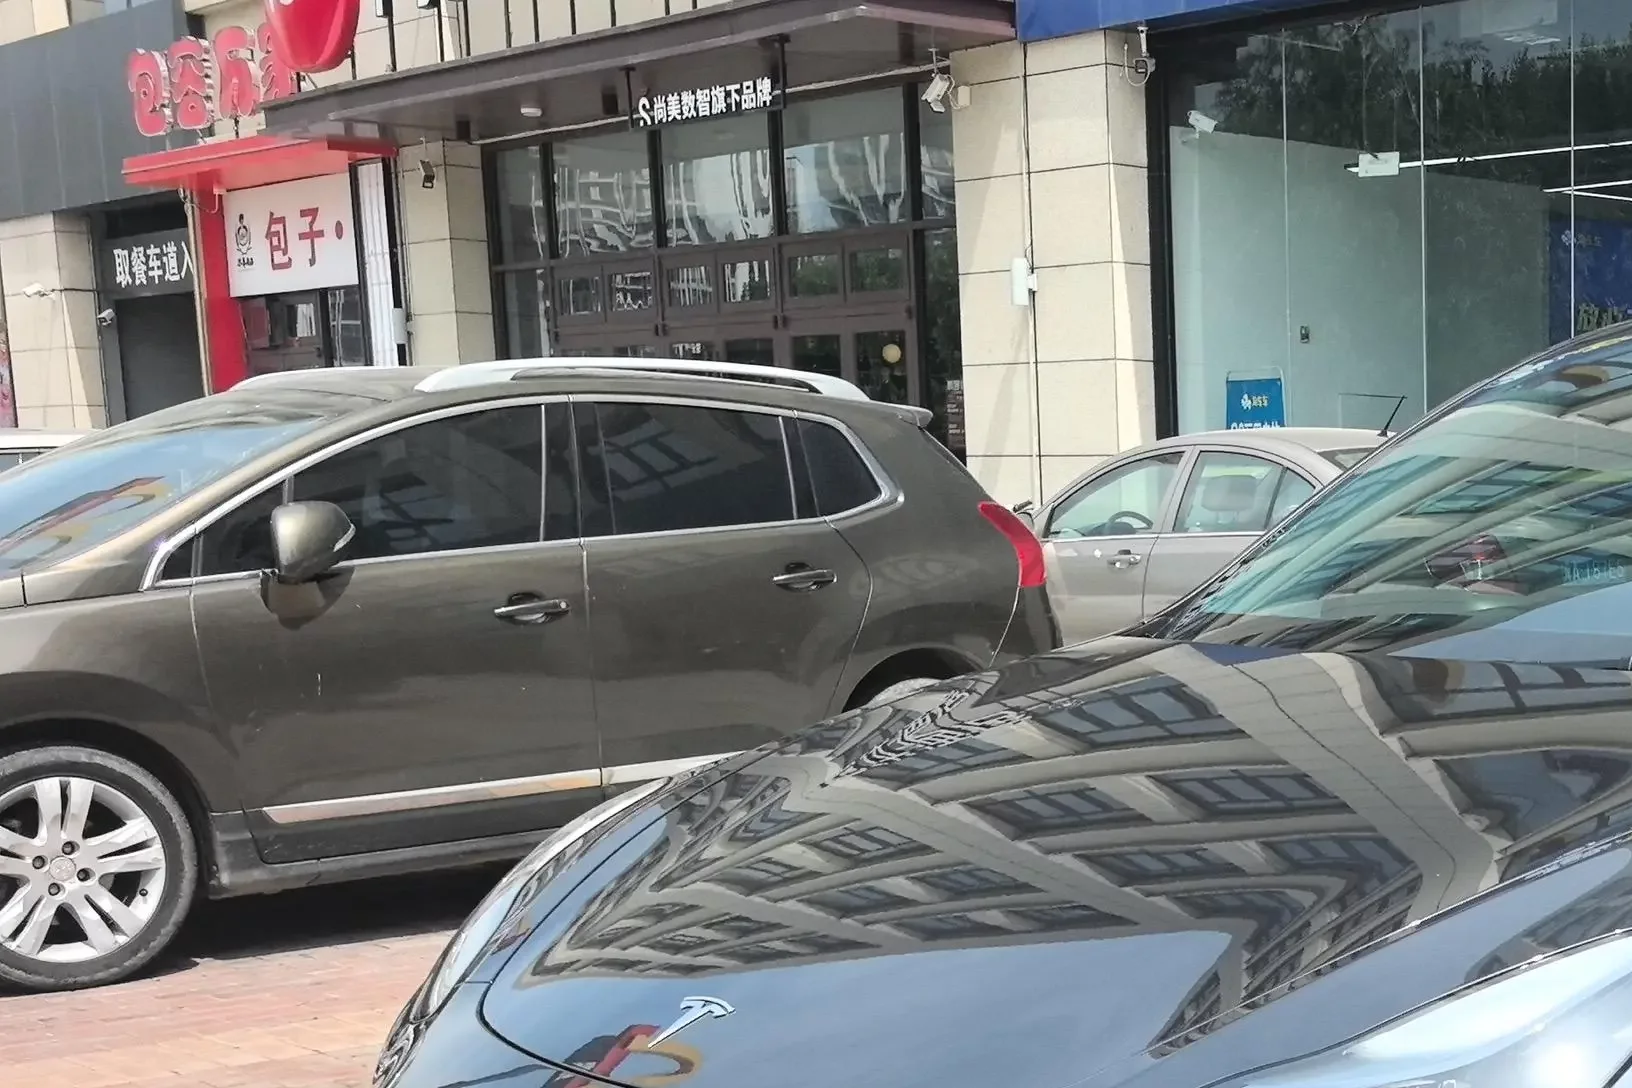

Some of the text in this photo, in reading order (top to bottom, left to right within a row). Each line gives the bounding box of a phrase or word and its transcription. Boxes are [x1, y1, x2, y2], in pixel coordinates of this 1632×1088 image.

[653, 77, 773, 125] 尚美数智旗下品牌
[113, 241, 195, 289] 取餐车道入
